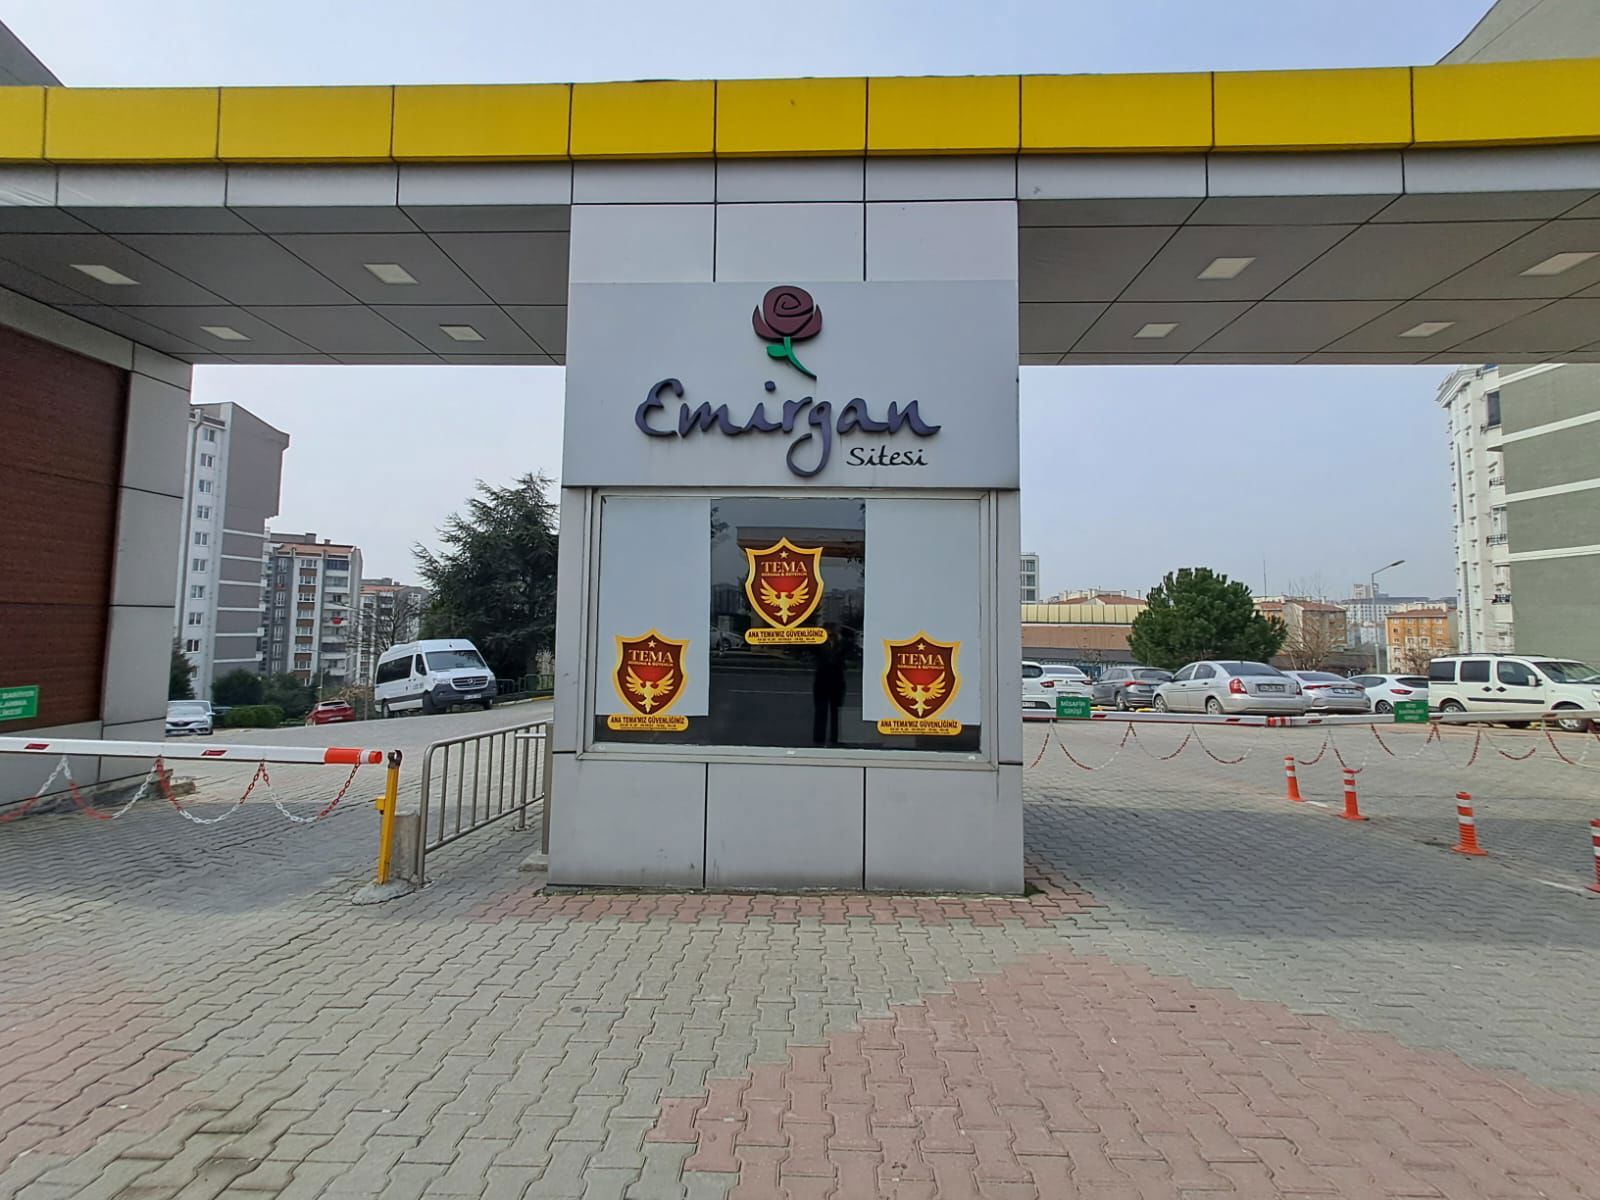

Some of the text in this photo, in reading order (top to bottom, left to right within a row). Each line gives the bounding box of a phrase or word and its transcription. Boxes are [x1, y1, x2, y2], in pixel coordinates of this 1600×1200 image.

[635, 378, 942, 478] Emirgan
[846, 445, 928, 466] Sitesi
[761, 561, 808, 573] TEMA
[628, 649, 674, 663] TEMA
[897, 653, 945, 666] TEMA
